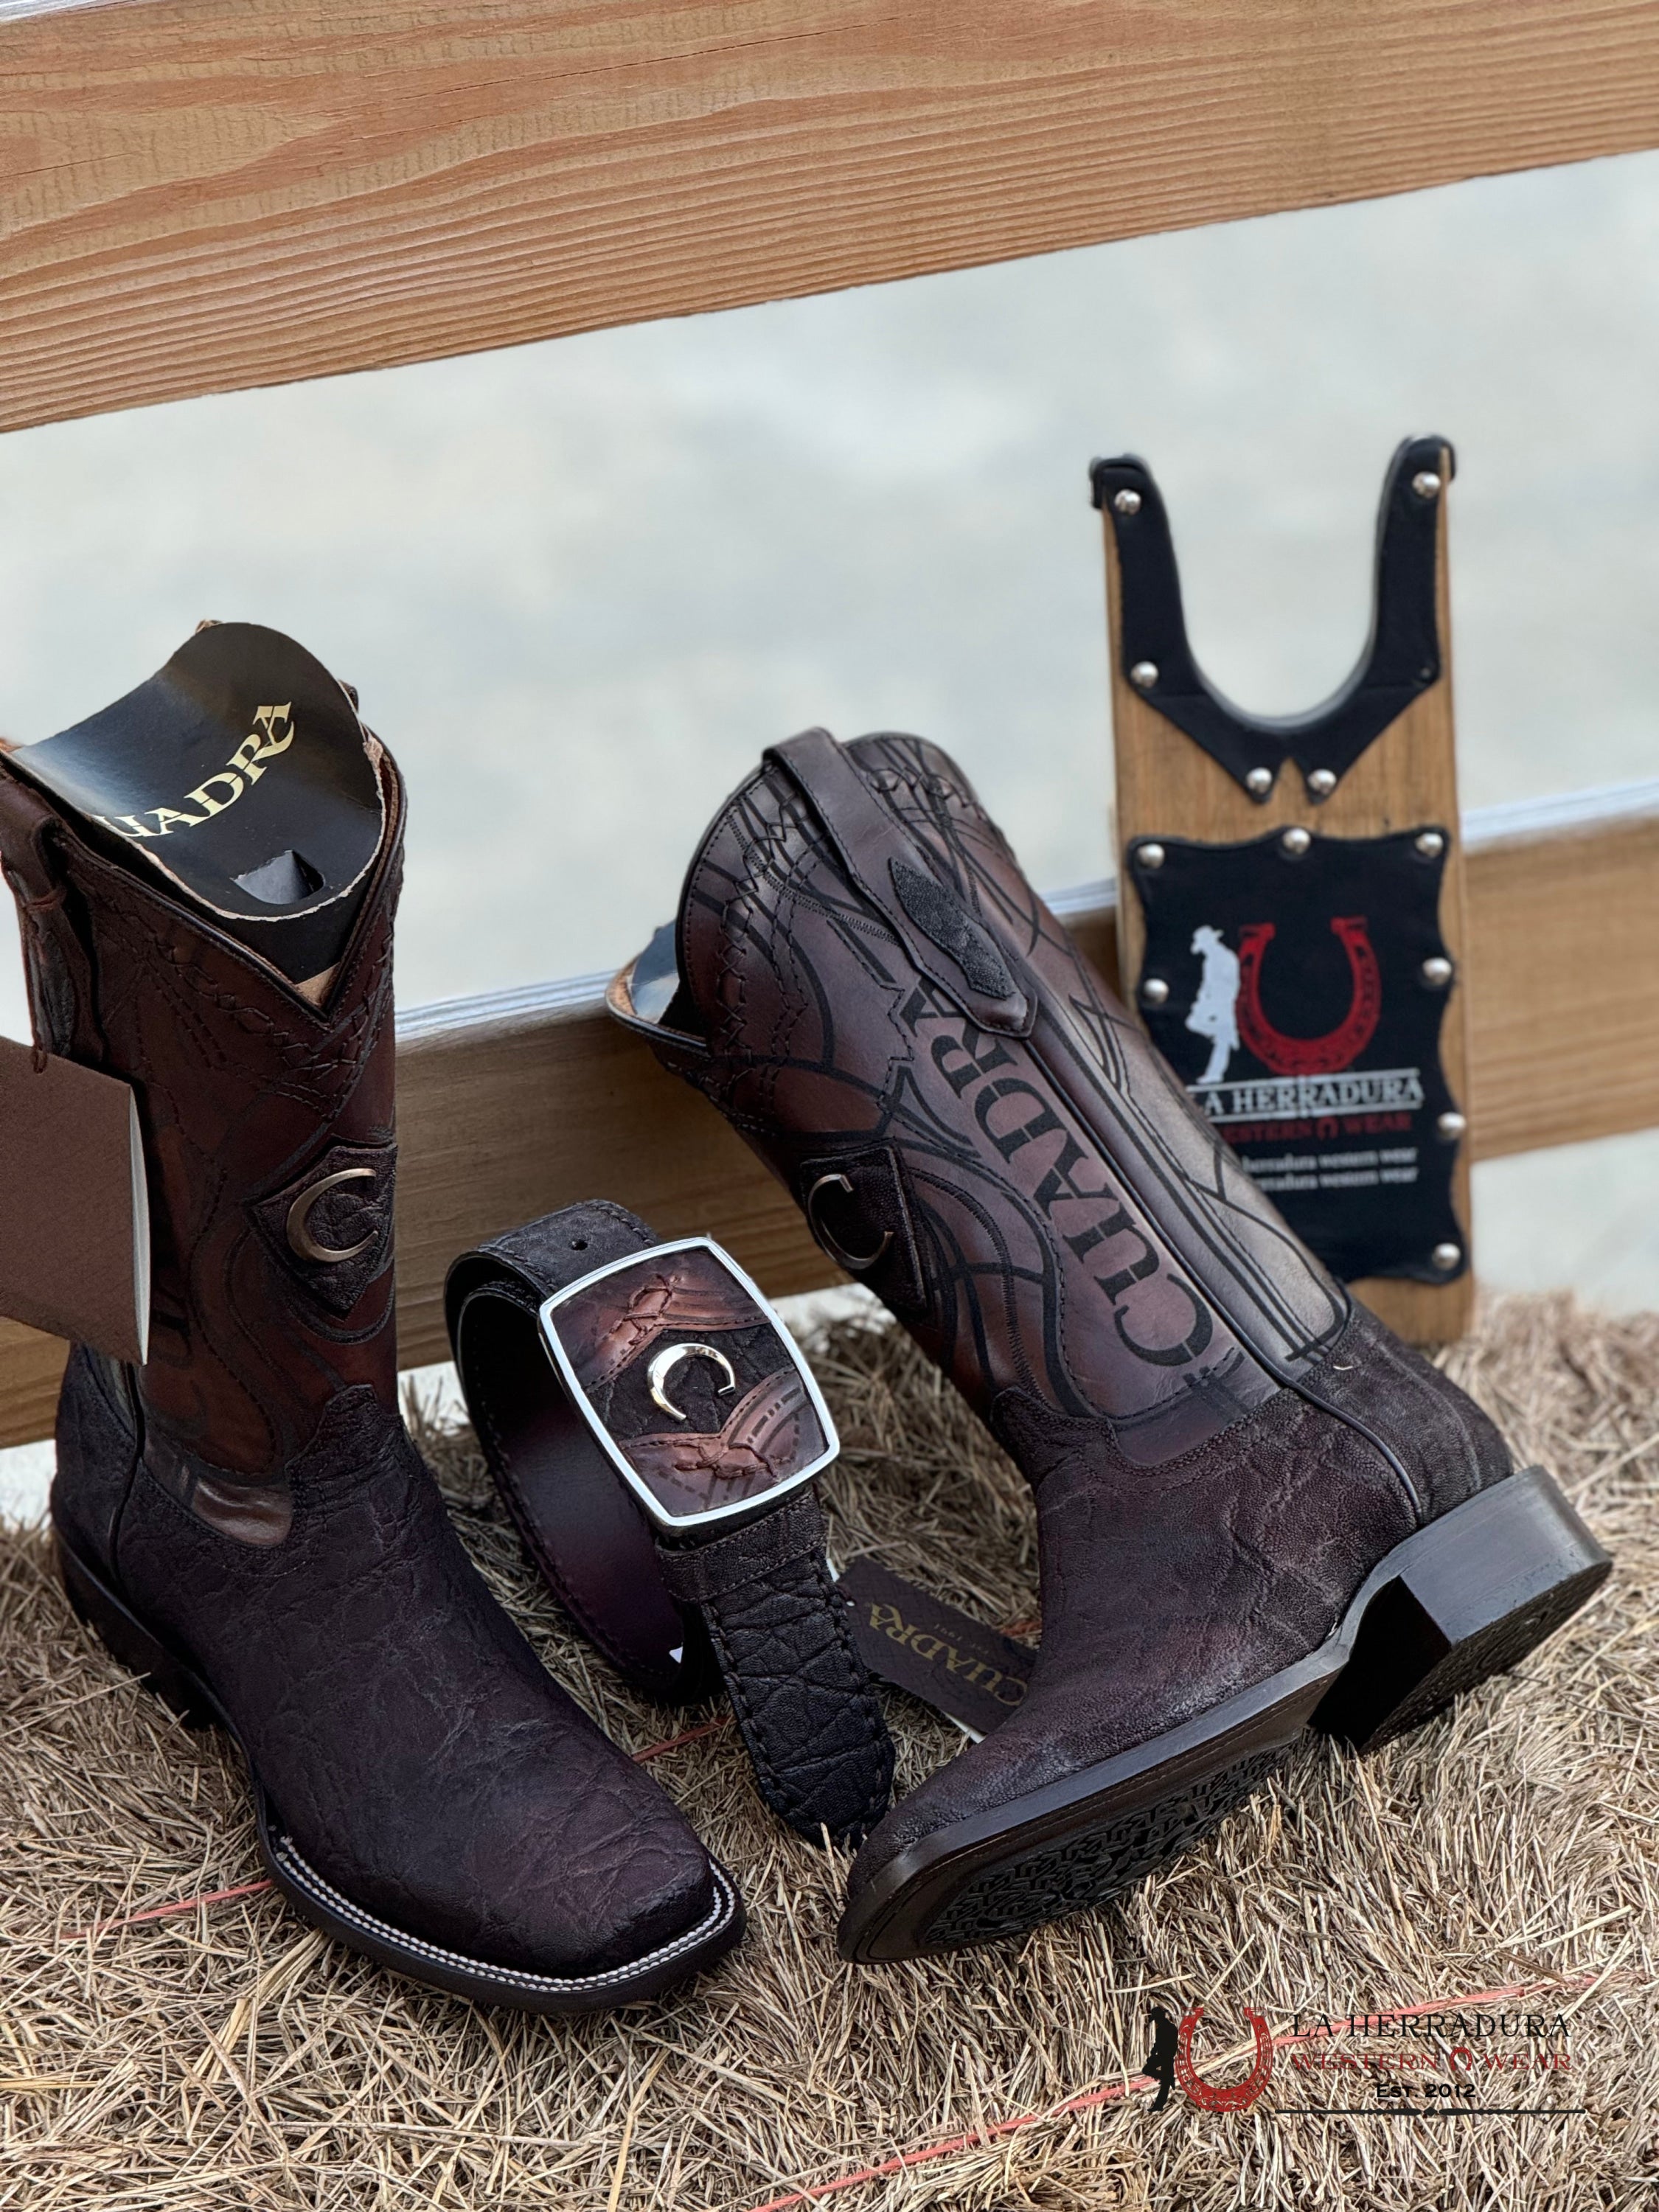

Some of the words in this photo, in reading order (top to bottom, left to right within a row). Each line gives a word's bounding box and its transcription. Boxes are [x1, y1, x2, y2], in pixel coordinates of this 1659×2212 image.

[91, 701, 294, 837] UADRA
[1222, 1121, 1312, 1144] ESTERN
[1233, 1077, 1425, 1113] HERRADURA
[287, 1168, 378, 1263] C
[869, 1602, 1028, 1706] CUADRA
